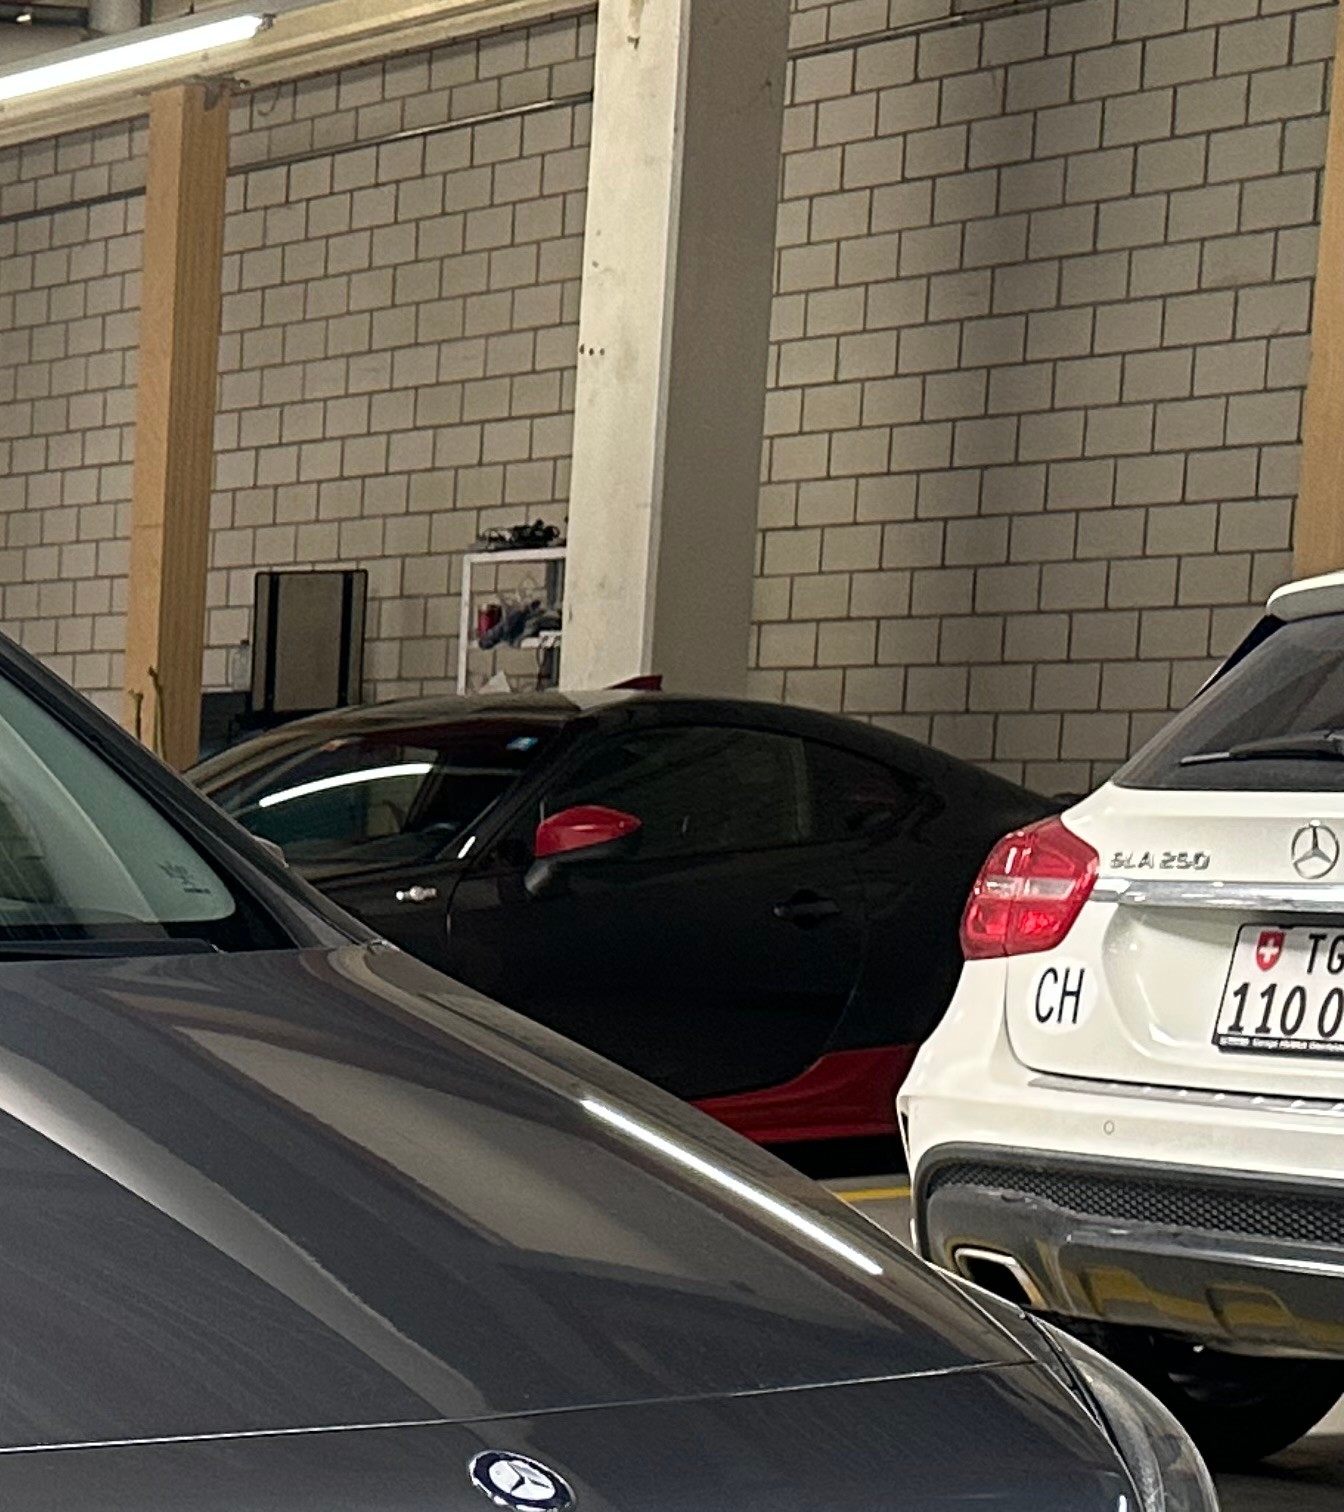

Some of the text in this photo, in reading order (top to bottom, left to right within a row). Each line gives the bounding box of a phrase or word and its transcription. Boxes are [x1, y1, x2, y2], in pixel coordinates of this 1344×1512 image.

[1159, 851, 1212, 871] 250
[1307, 933, 1344, 975] TG
[1035, 967, 1085, 1024] CH
[1227, 982, 1307, 1036] 110
